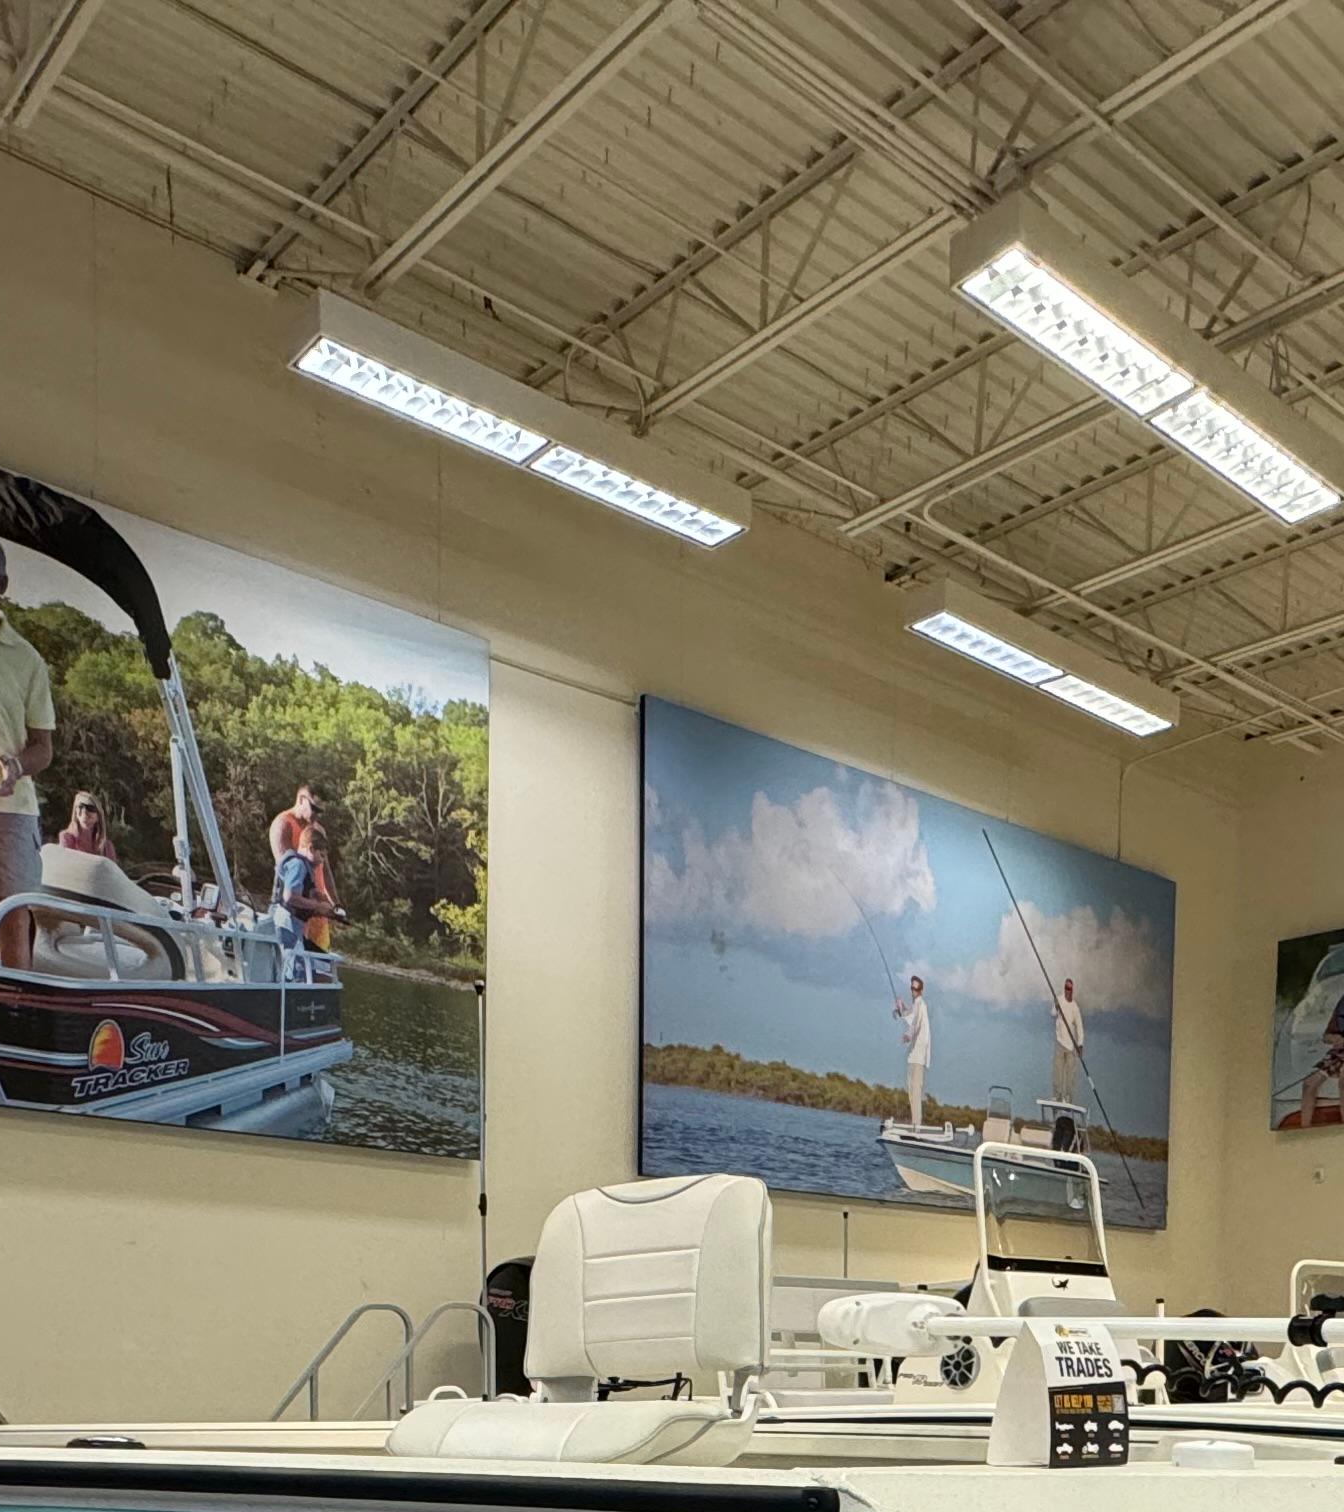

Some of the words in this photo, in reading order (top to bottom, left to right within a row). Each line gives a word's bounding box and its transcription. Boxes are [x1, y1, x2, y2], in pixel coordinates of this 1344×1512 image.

[125, 1031, 170, 1064] Sun
[71, 1058, 190, 1098] TRACKER
[1056, 1341, 1075, 1355] WE
[1075, 1341, 1103, 1356] TAKE
[1055, 1356, 1113, 1378] TRADES
